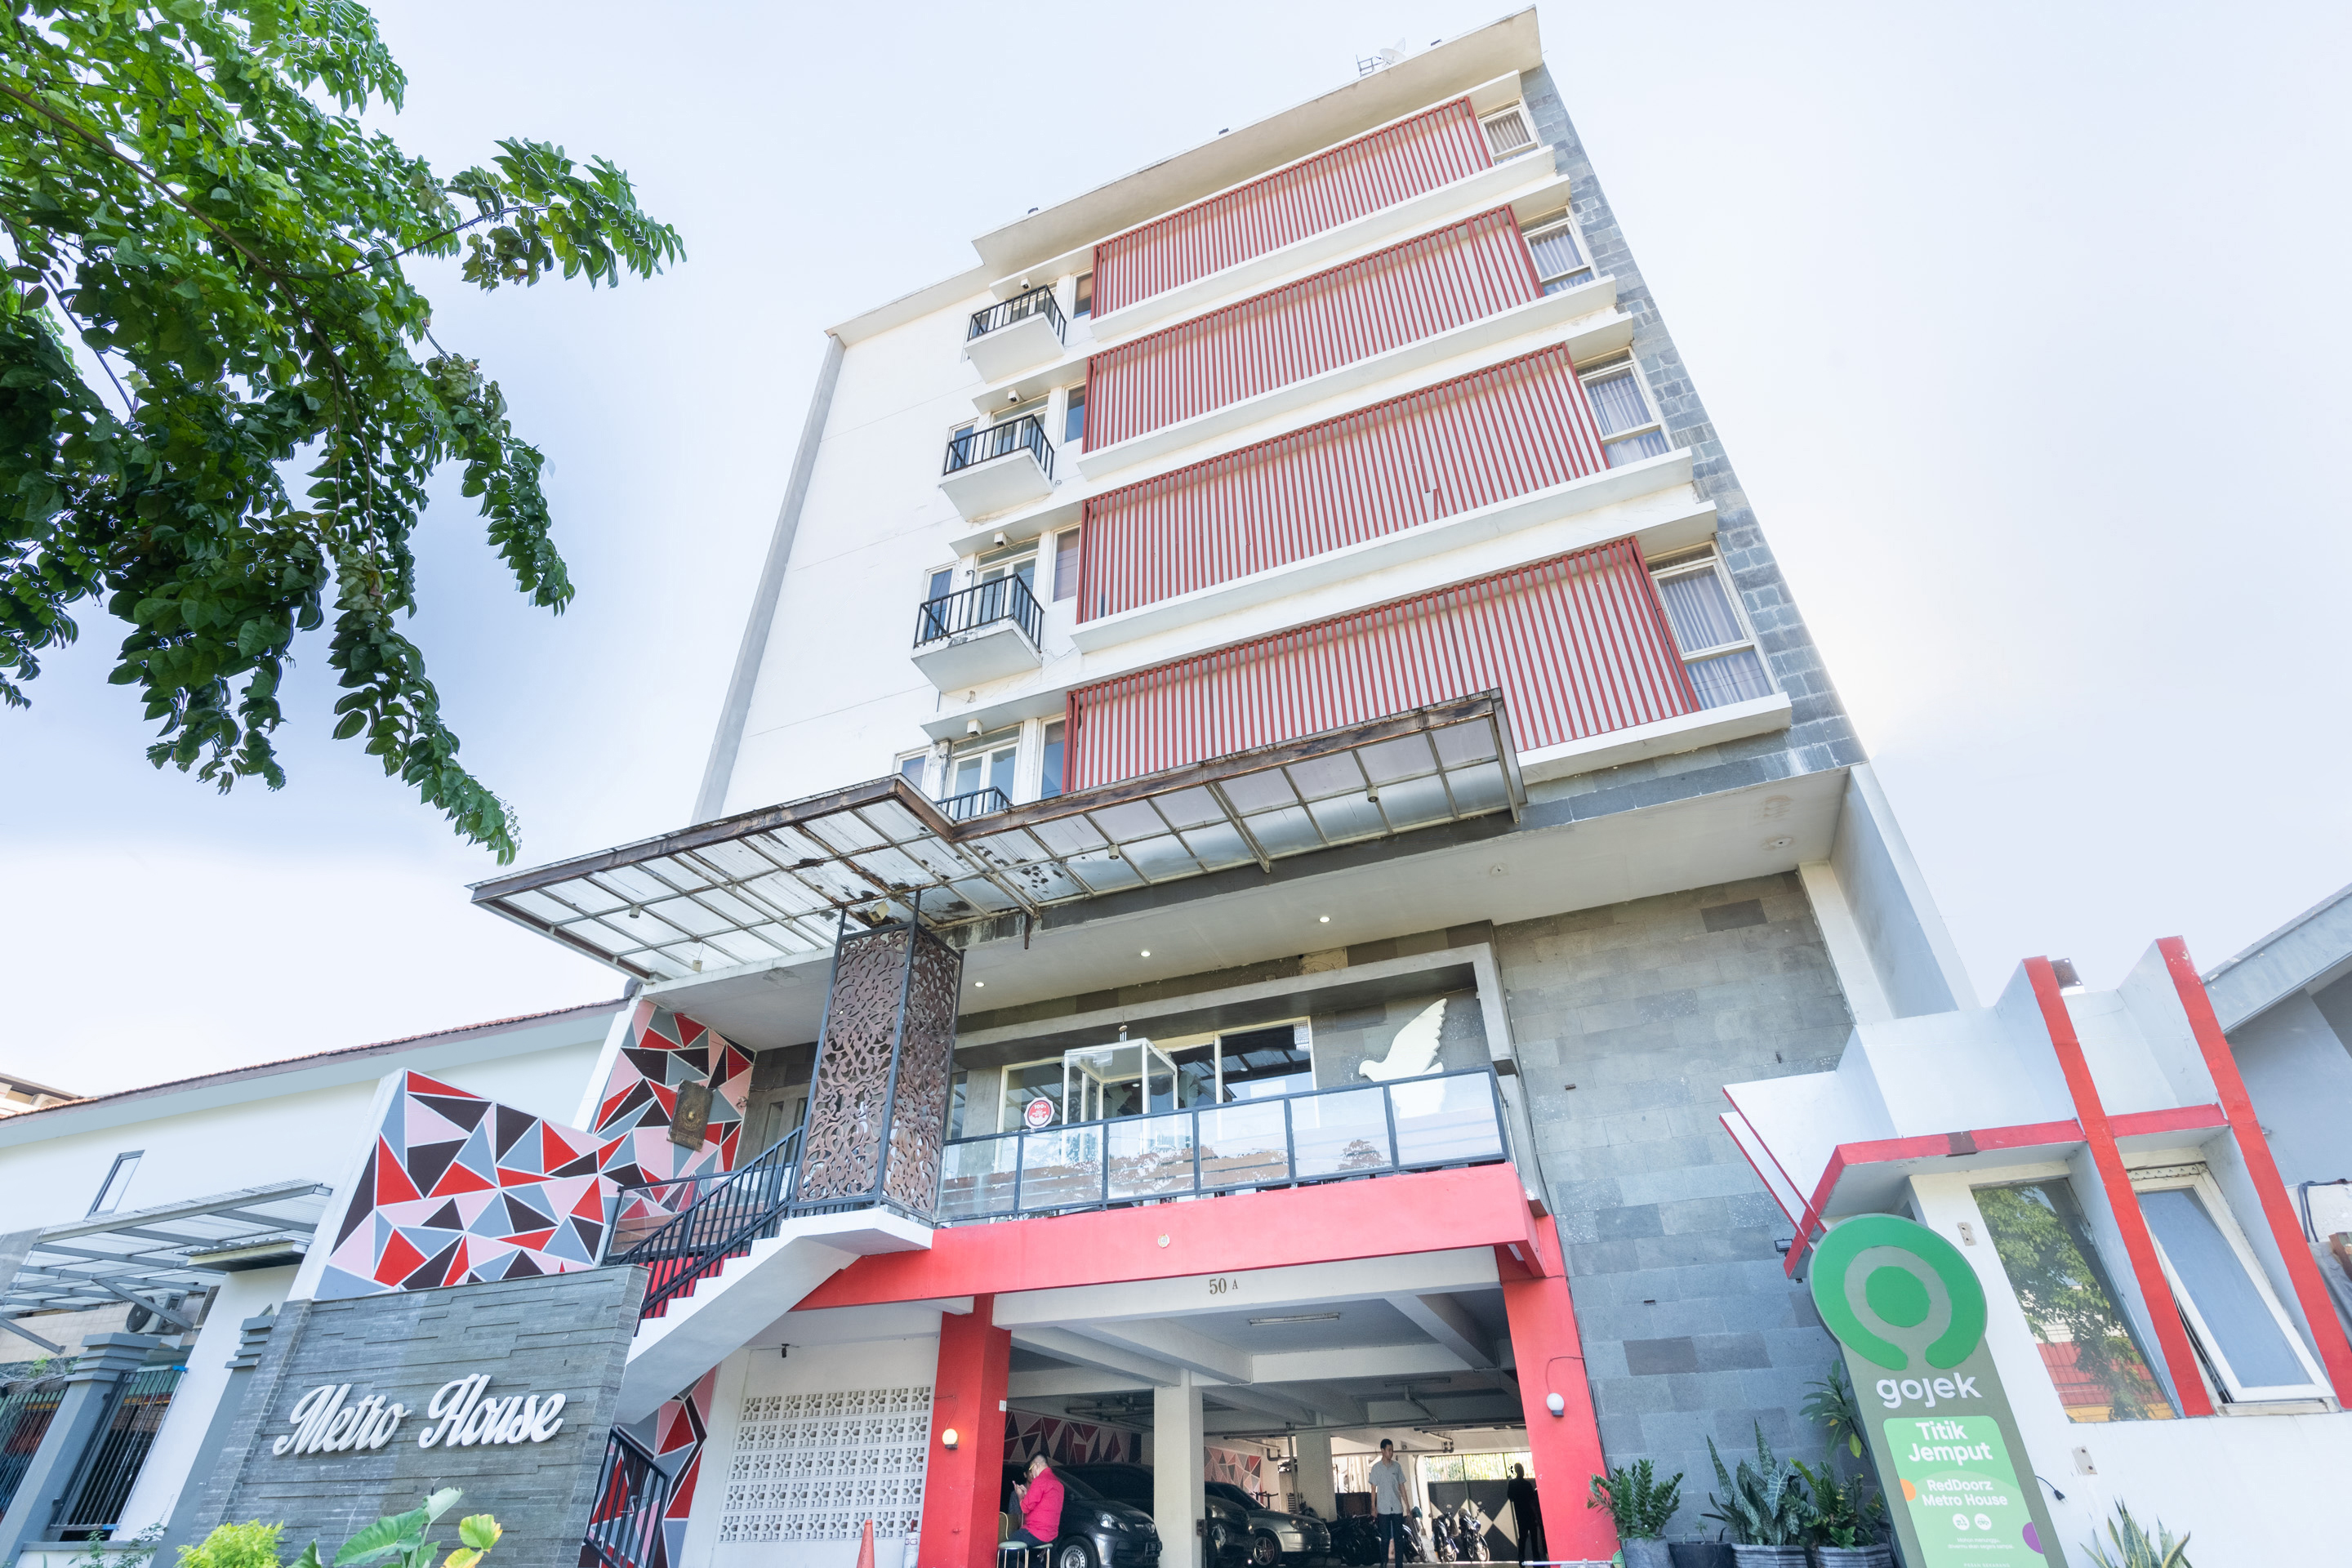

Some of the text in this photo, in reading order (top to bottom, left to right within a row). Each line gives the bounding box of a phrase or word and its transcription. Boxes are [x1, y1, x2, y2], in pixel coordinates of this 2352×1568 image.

[1209, 1277, 1238, 1294] 50 A
[1876, 1372, 1983, 1409] gojek
[272, 1373, 567, 1456] Metro House
[1915, 1420, 1968, 1441] Titik
[1908, 1441, 1993, 1466] Jemput
[1927, 1479, 1993, 1491] RedDoorz
[1922, 1494, 2008, 1506] Metro House
